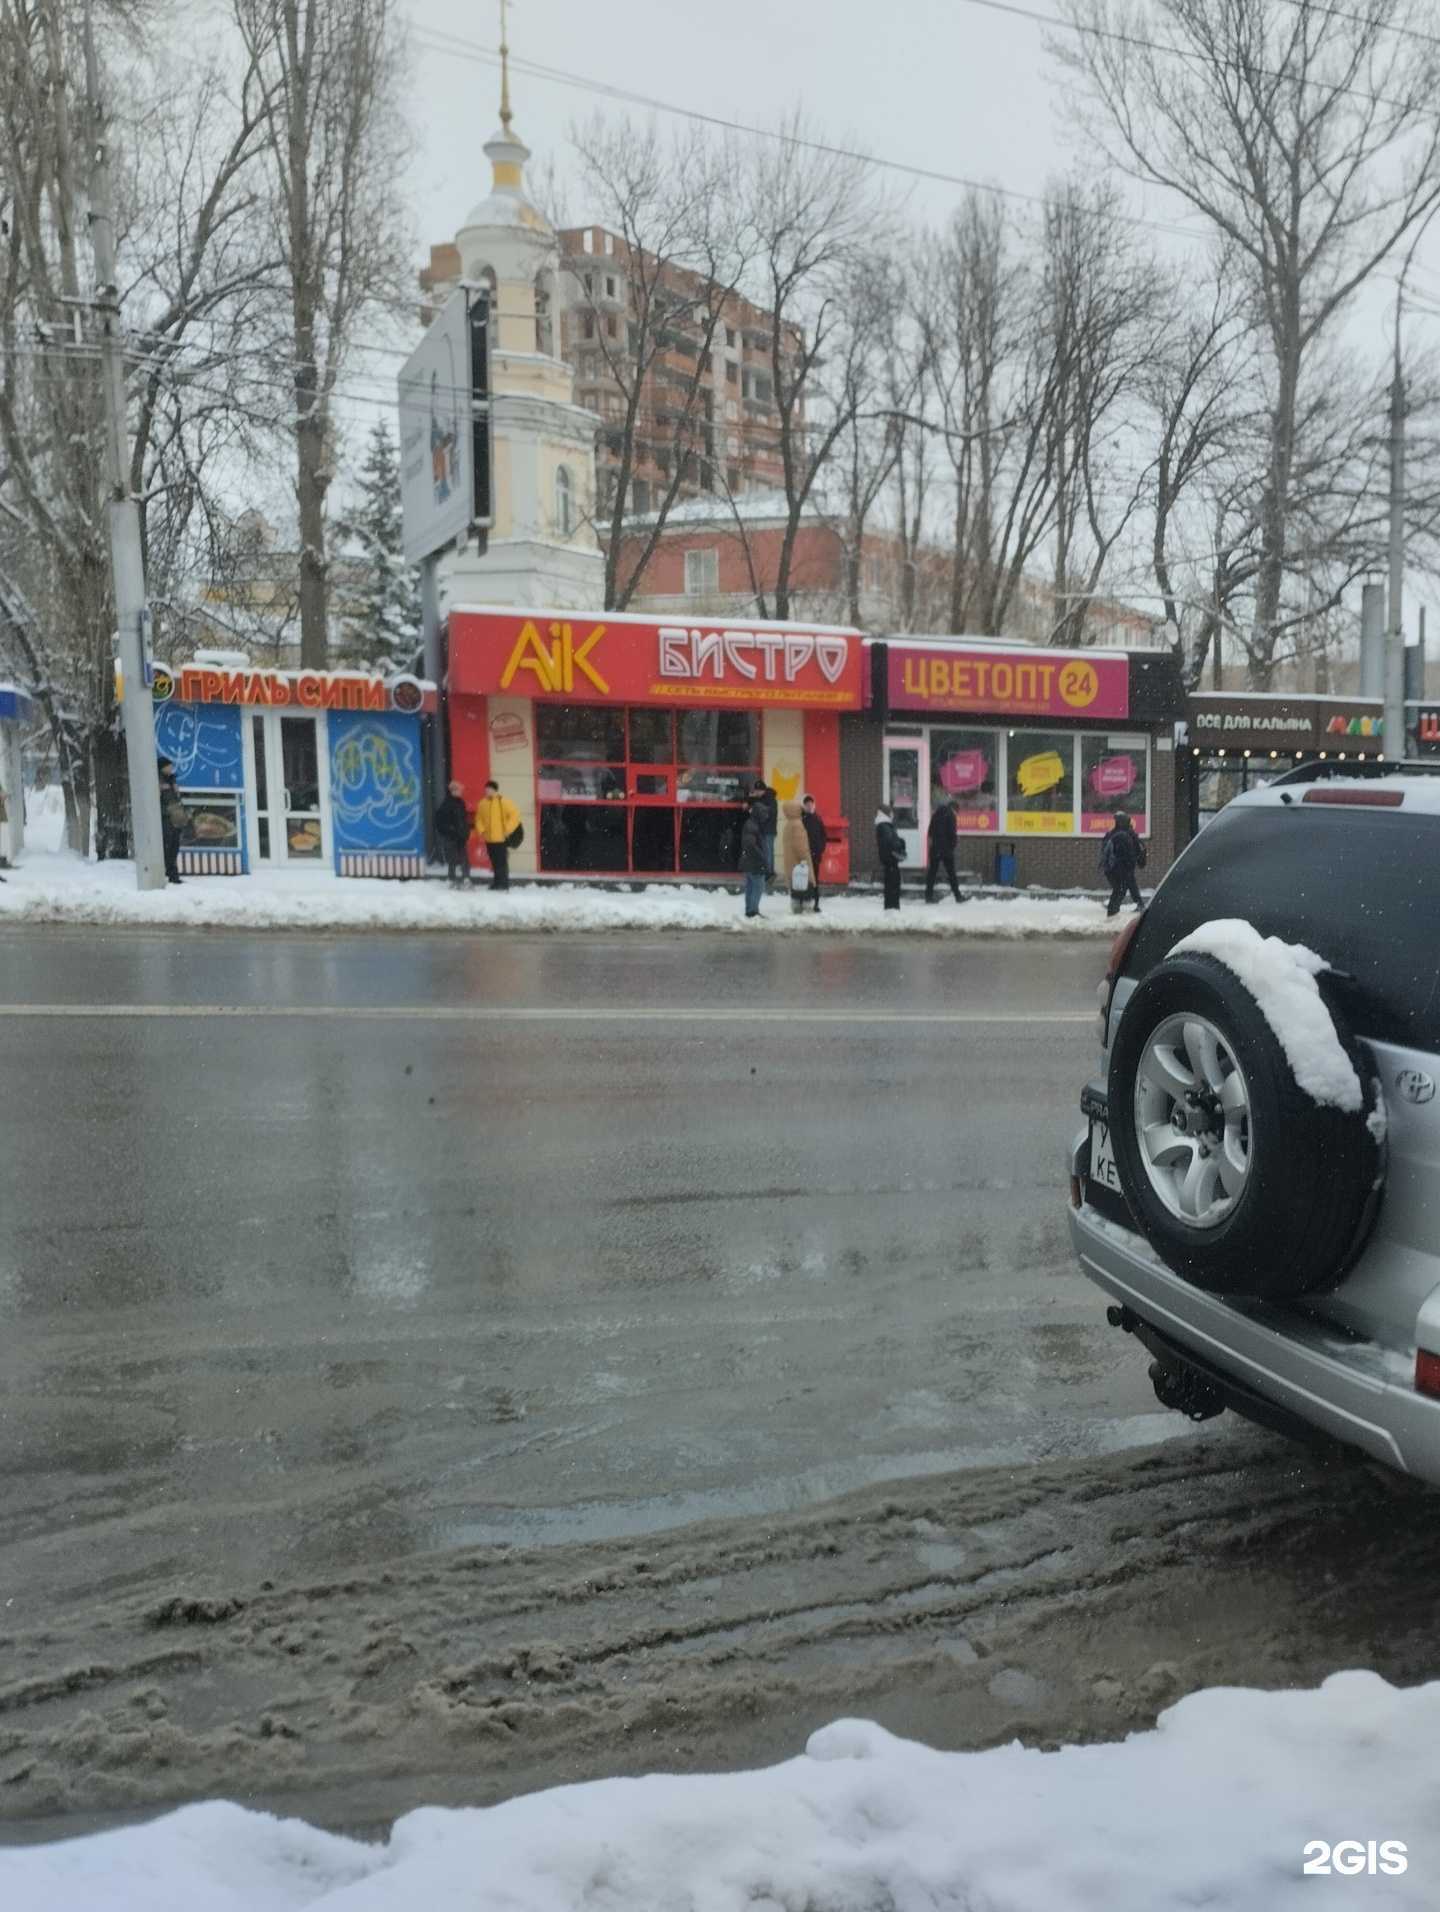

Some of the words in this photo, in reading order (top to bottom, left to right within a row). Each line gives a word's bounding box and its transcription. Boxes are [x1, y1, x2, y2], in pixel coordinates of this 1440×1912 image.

[658, 627, 848, 683] БИСТРО
[181, 669, 290, 706] ГРИЛЬ
[296, 674, 386, 711] СИТИ
[904, 657, 1055, 701] ЦВЕТОПТ
[1065, 671, 1092, 697] 24
[1223, 714, 1251, 731] ДЛЯ
[1252, 717, 1312, 732] КАЛЬЯНА
